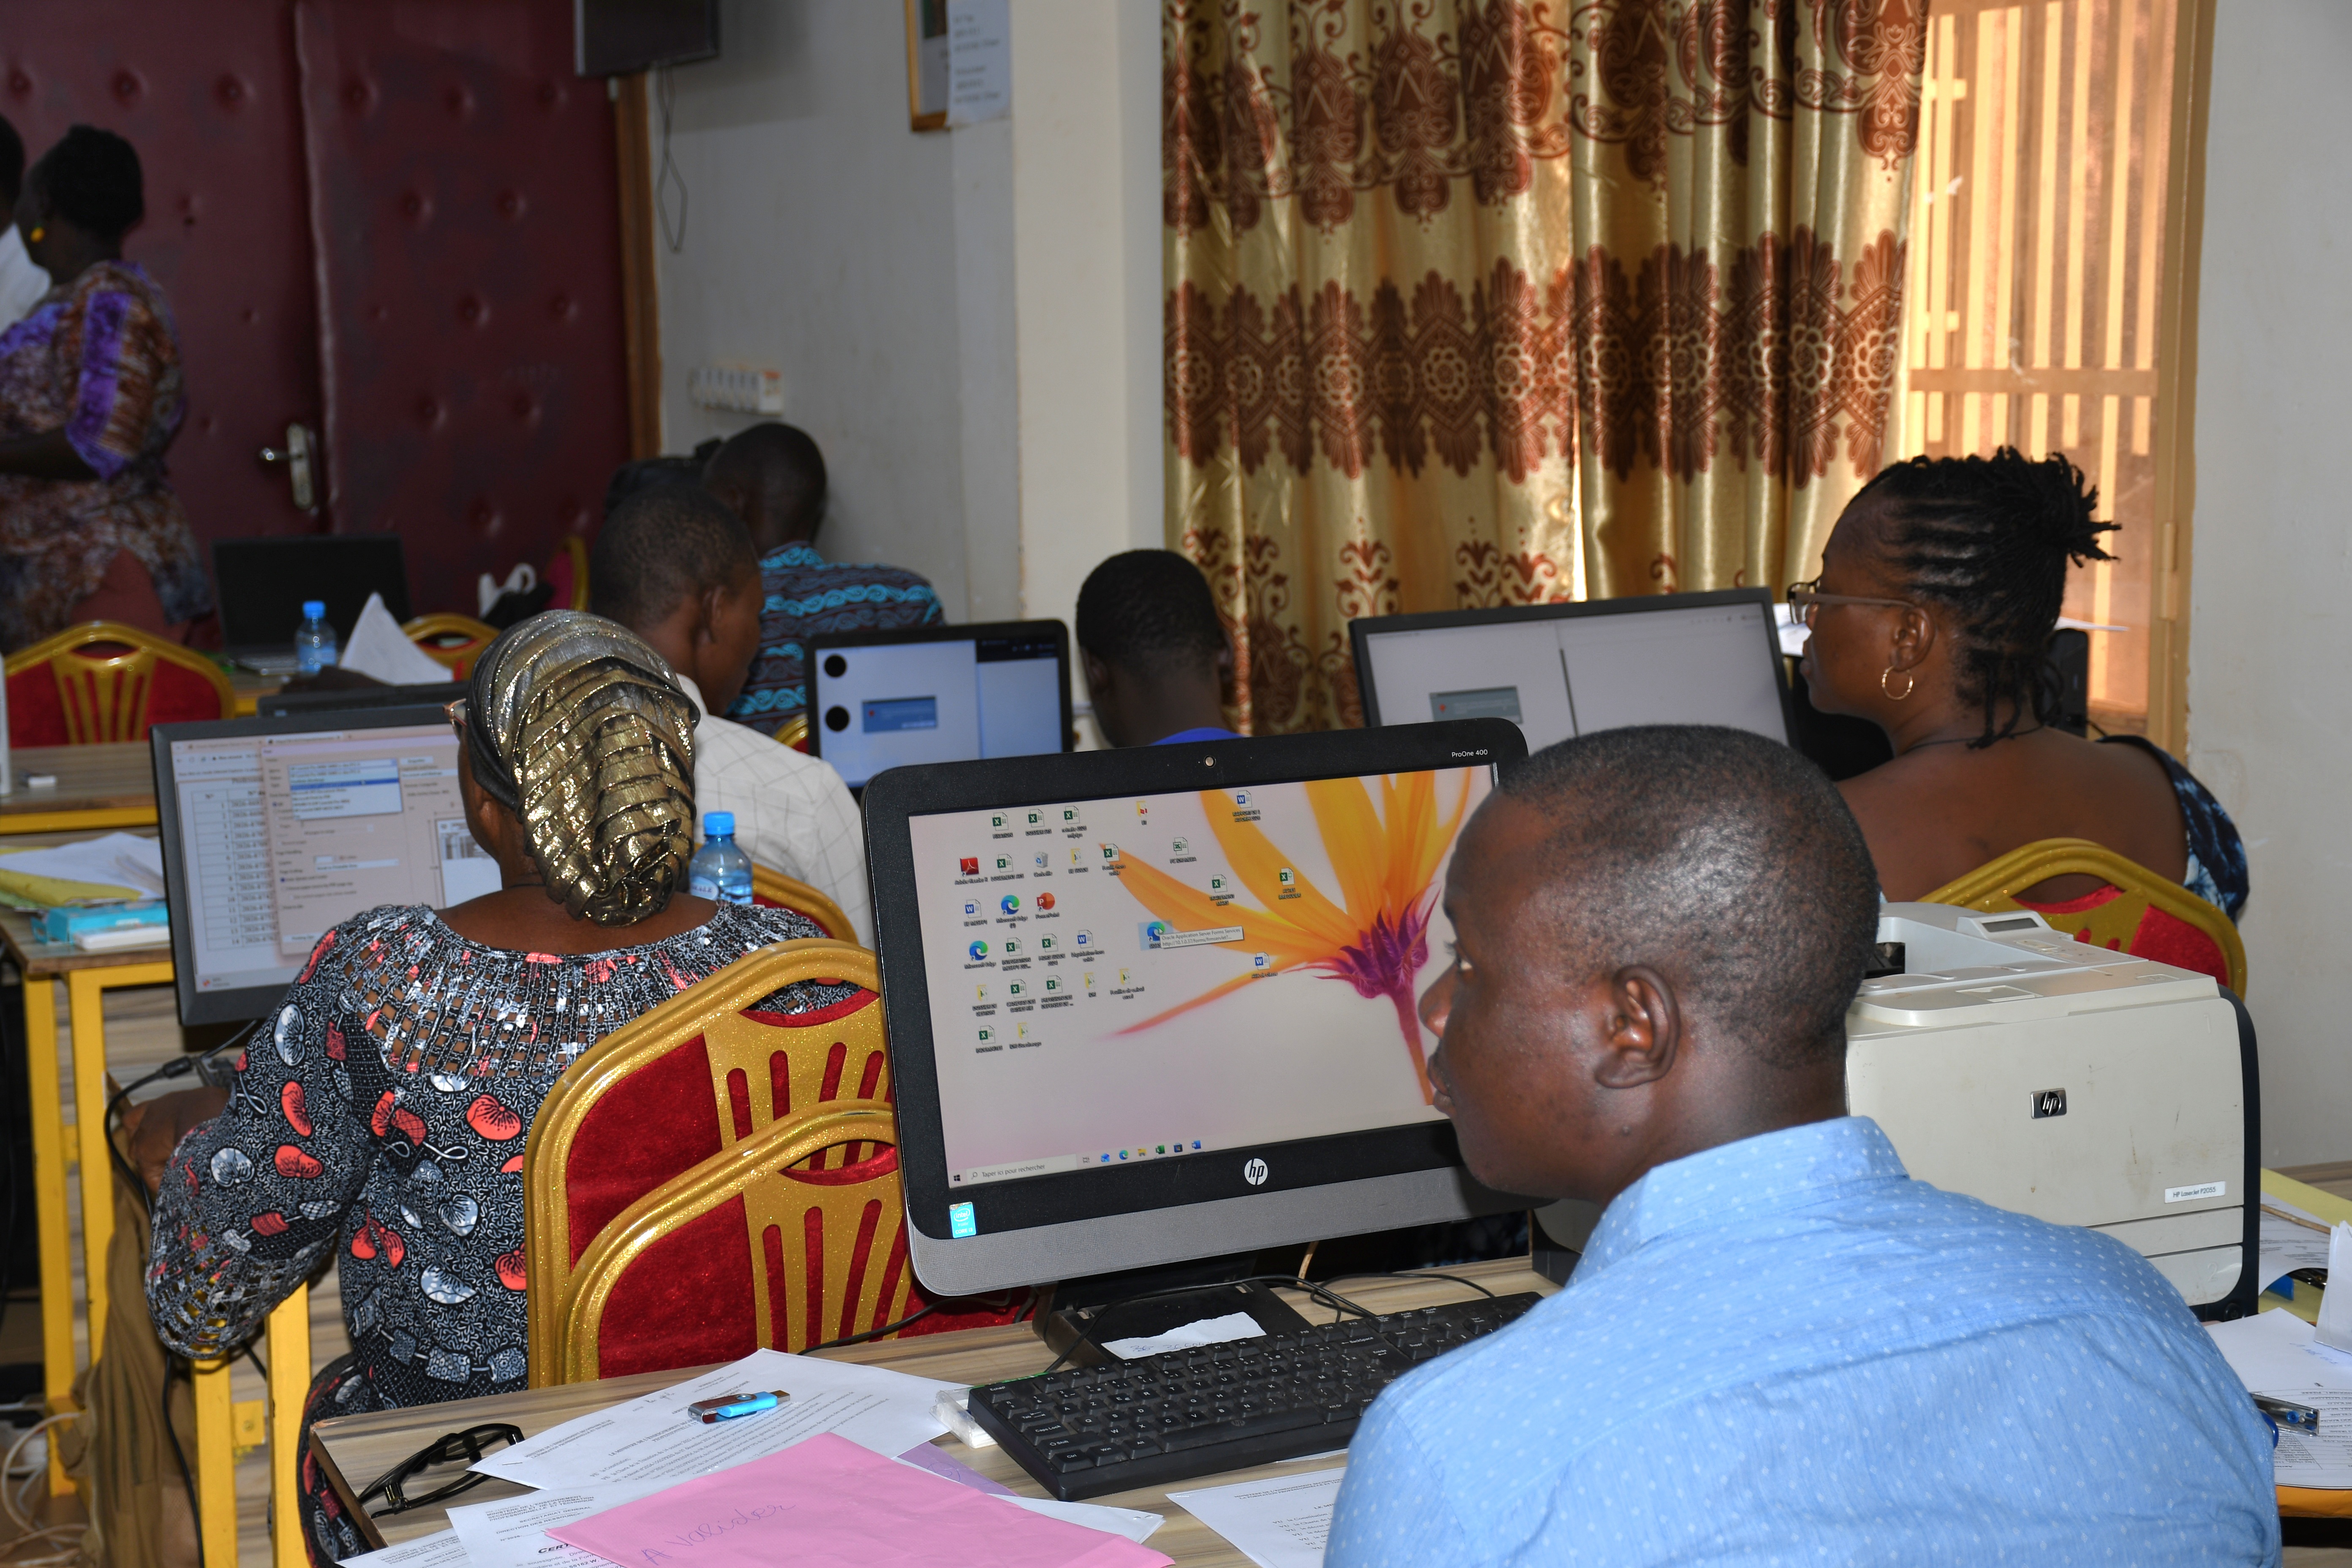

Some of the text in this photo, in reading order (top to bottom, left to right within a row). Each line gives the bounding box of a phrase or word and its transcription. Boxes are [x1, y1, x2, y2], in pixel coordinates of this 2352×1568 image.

[2041, 1091, 2060, 1117] hp
[1018, 1164, 1045, 1172] rechercher
[1247, 1159, 1266, 1185] hp
[956, 1210, 968, 1218] intel
[487, 1508, 519, 1516] MINISTERE
[529, 1495, 581, 1508] L'ENSEIGNEMENT
[488, 1509, 527, 1519] SECONDAIRE
[490, 1506, 547, 1521] PROFESSIONNELLE
[520, 1511, 561, 1523] SECRETARIAT
[1294, 1513, 1328, 1521] Constitution
[496, 1524, 528, 1534] DIRECTION
